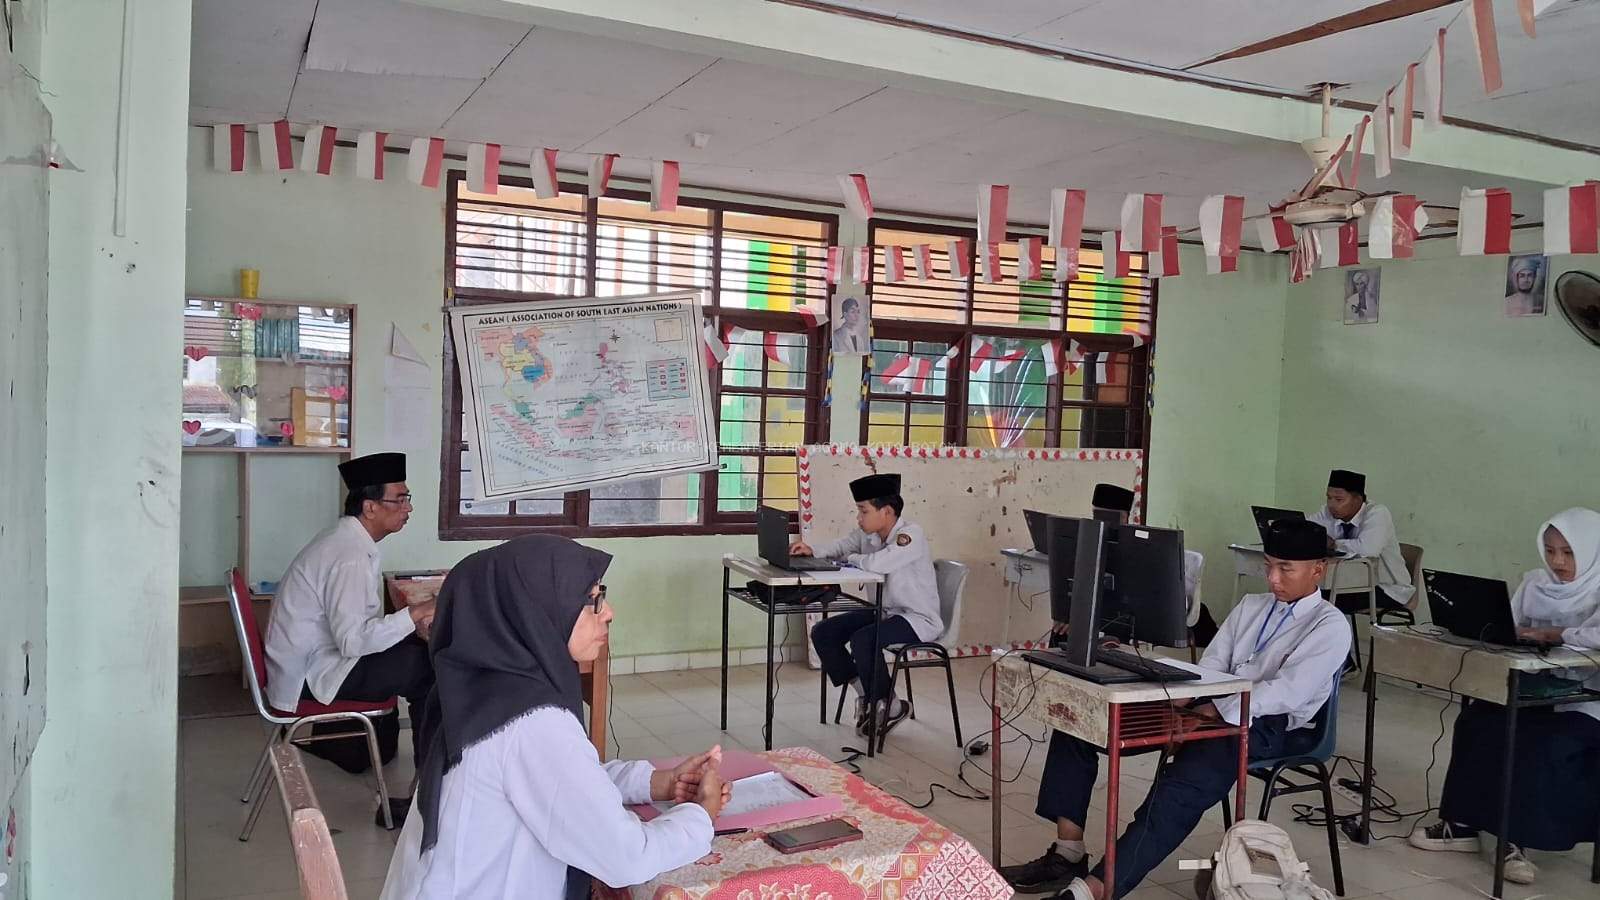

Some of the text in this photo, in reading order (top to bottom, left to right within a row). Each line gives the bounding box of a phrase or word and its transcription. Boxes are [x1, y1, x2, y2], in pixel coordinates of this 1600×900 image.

[478, 316, 505, 325] ASEAN
[511, 311, 563, 323] ASSOCIATION
[564, 310, 575, 318] OF
[576, 307, 602, 318] SOUTH
[603, 306, 621, 316] EAST
[621, 304, 645, 314] ASIAN
[645, 301, 678, 312] NATIONS
